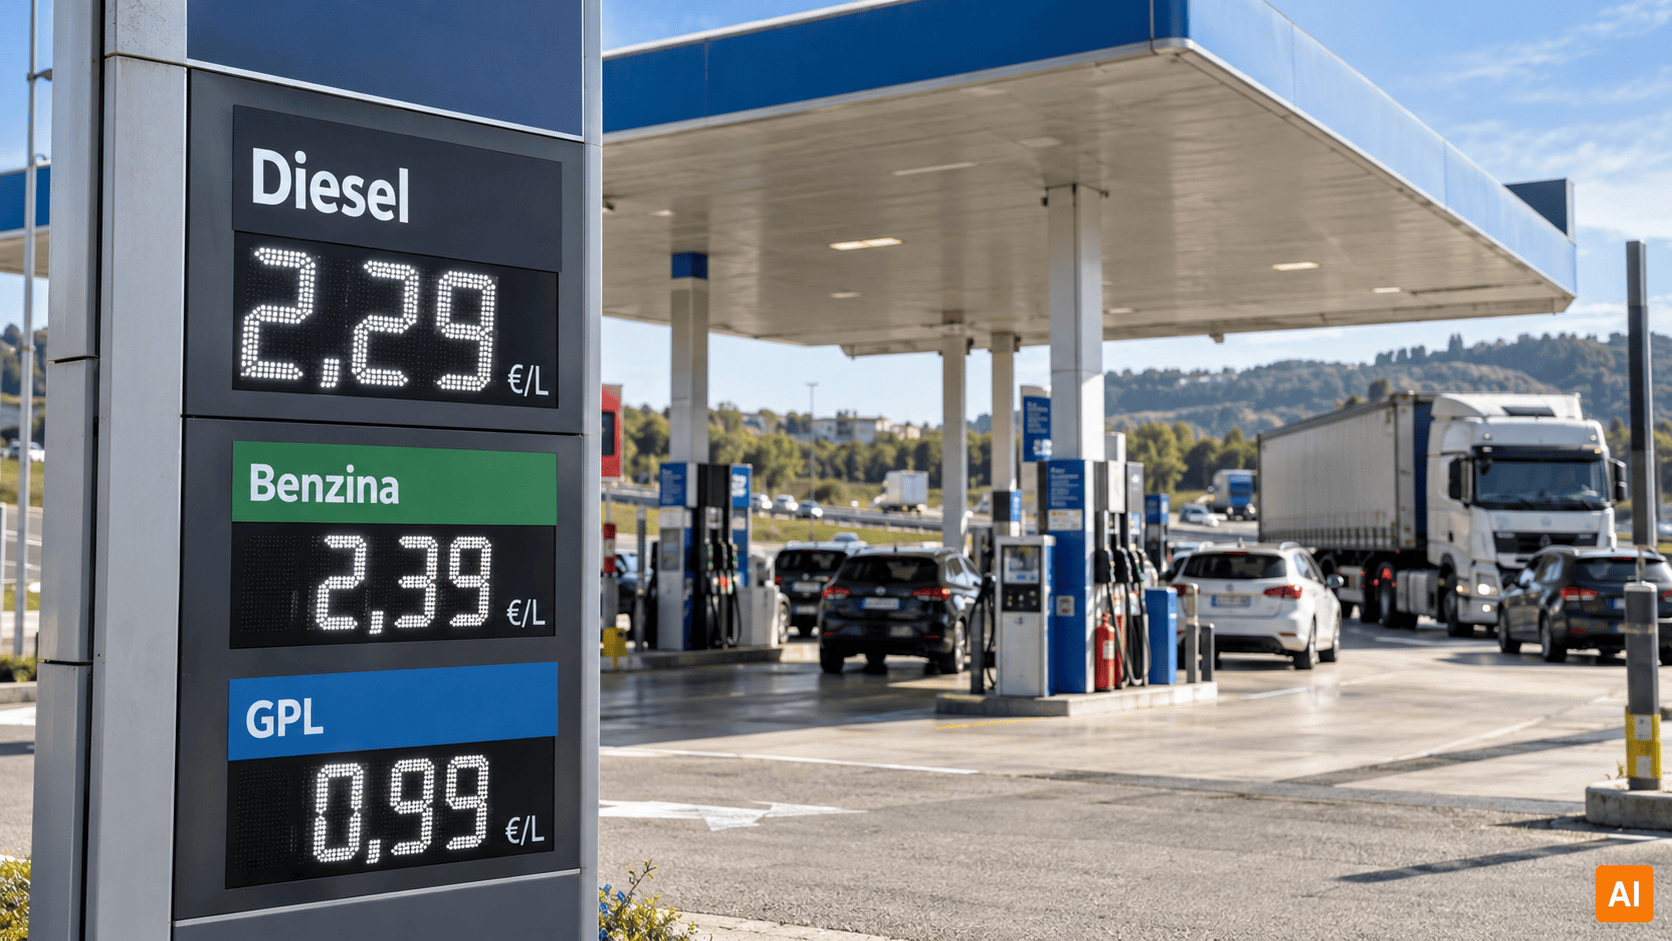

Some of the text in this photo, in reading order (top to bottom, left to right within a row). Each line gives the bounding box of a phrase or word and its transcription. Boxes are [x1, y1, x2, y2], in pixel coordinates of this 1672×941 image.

[252, 147, 409, 223] Diesel
[240, 246, 549, 397] 2,29 €/L
[250, 463, 399, 504] Benzina
[315, 534, 546, 635] 2,39 €/L
[246, 697, 324, 739] GPL
[312, 754, 545, 864] 0,99 €/L
